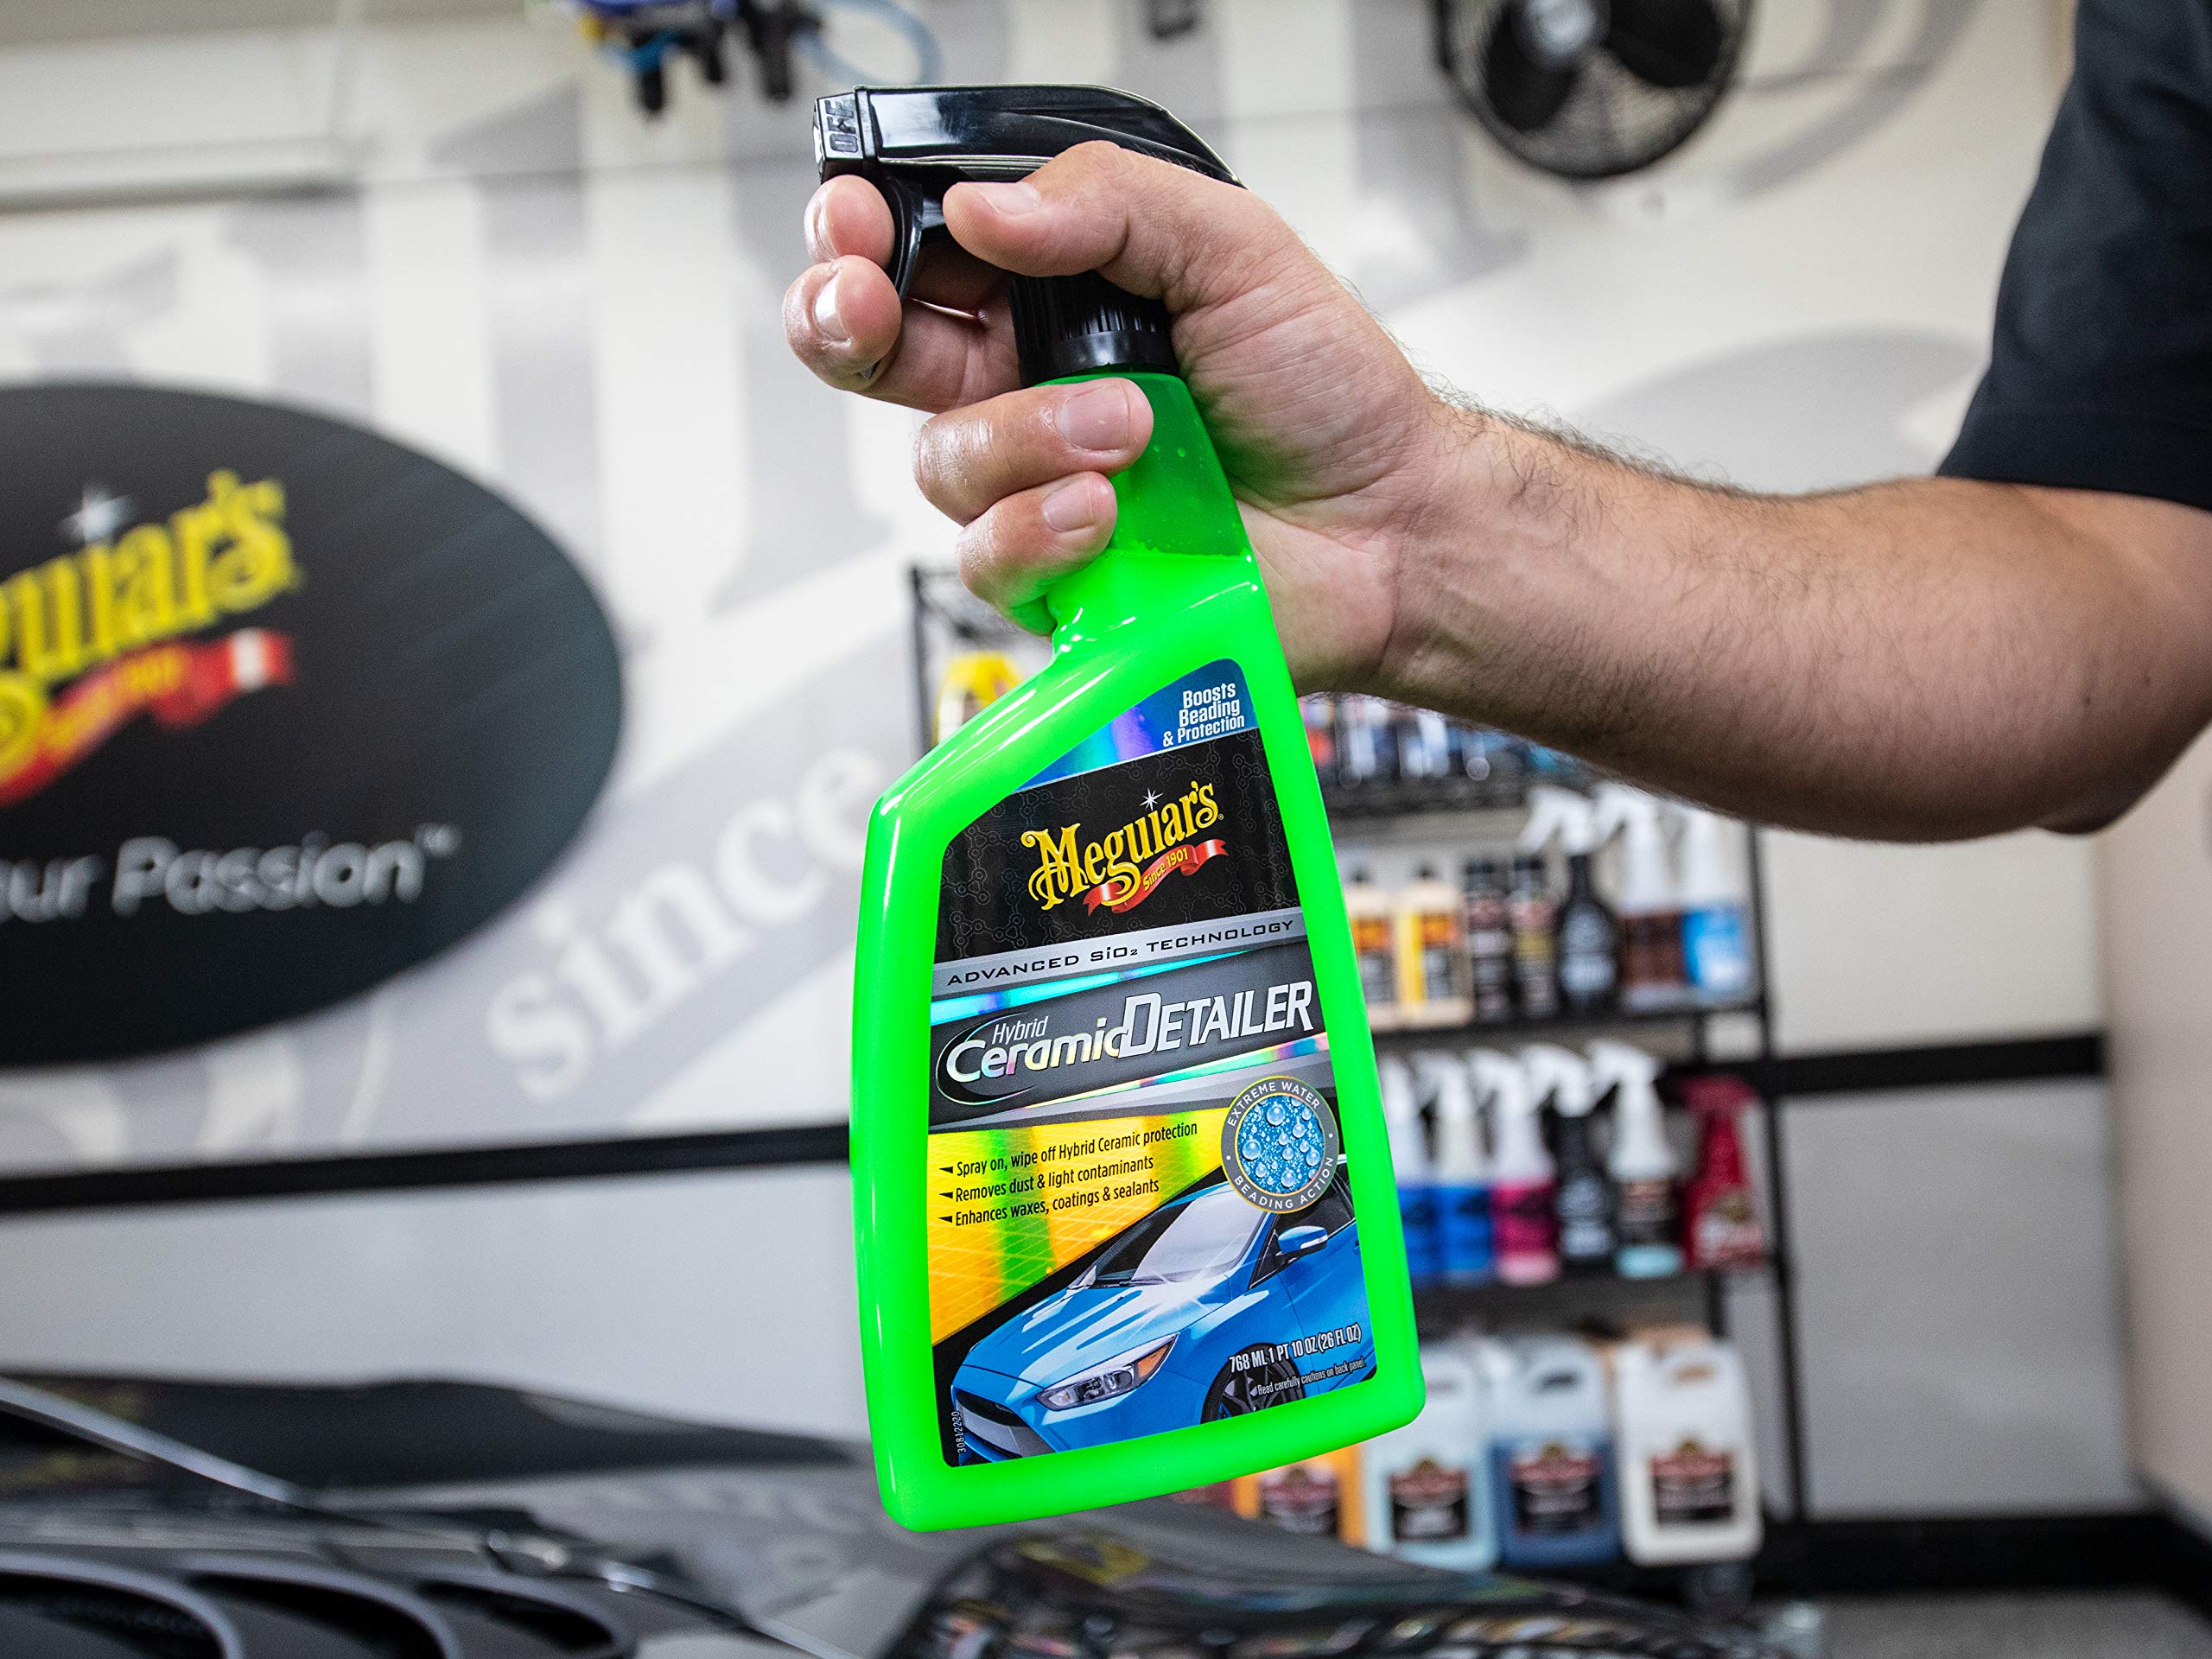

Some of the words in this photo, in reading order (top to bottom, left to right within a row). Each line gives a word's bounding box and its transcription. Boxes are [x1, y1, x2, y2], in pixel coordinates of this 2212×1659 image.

[824, 99, 859, 154] OFF
[1179, 699, 1241, 728] Beading
[1183, 683, 1236, 709] Boosts
[1162, 730, 1174, 747] &
[1177, 715, 1245, 743] Protection
[0, 857, 104, 924] ur
[1142, 863, 1166, 892] Since
[1166, 847, 1189, 868] 1901
[484, 747, 885, 1102] since
[947, 955, 1079, 986] ADVANCED
[1147, 920, 1294, 952] TECHNOLOGY
[991, 1015, 1049, 1046] Hybrid
[1227, 1081, 1277, 1127] EXTREME
[1281, 1081, 1320, 1109] WATER
[957, 1158, 988, 1177] Spray
[990, 1158, 1008, 1172] on,
[1011, 1150, 1039, 1168] wipe
[1040, 1145, 1057, 1162] off
[1058, 1138, 1096, 1160] Hybrid
[1098, 1132, 1141, 1153] Ceramic
[1143, 1122, 1198, 1146] protection
[956, 1180, 1007, 1203] Removes
[1009, 1174, 1034, 1194] dust
[1037, 1173, 1046, 1189] &
[1048, 1168, 1075, 1190] light
[1077, 1155, 1154, 1182] contaminants
[956, 1204, 1008, 1226] Enhances
[1010, 1200, 1050, 1218] waxes,
[1052, 1188, 1100, 1211] coatings
[1103, 1186, 1111, 1201] &
[1114, 1178, 1160, 1200] sealants
[1234, 1175, 1294, 1210] BEADING
[1300, 1157, 1334, 1205] ACTION
[1229, 1354, 1250, 1373] 768
[1251, 1350, 1268, 1368] ML
[1268, 1348, 1275, 1363] 1
[1277, 1343, 1290, 1362] PT
[1292, 1340, 1305, 1357] 10
[1305, 1336, 1319, 1354] OZ
[1335, 1329, 1347, 1345] FL
[1346, 1323, 1362, 1344] OZ)
[1258, 1383, 1274, 1396] Read
[1275, 1376, 1300, 1392] carefully
[1300, 1370, 1326, 1384] cautions
[1326, 1367, 1334, 1377] on
[1334, 1362, 1350, 1376] back
